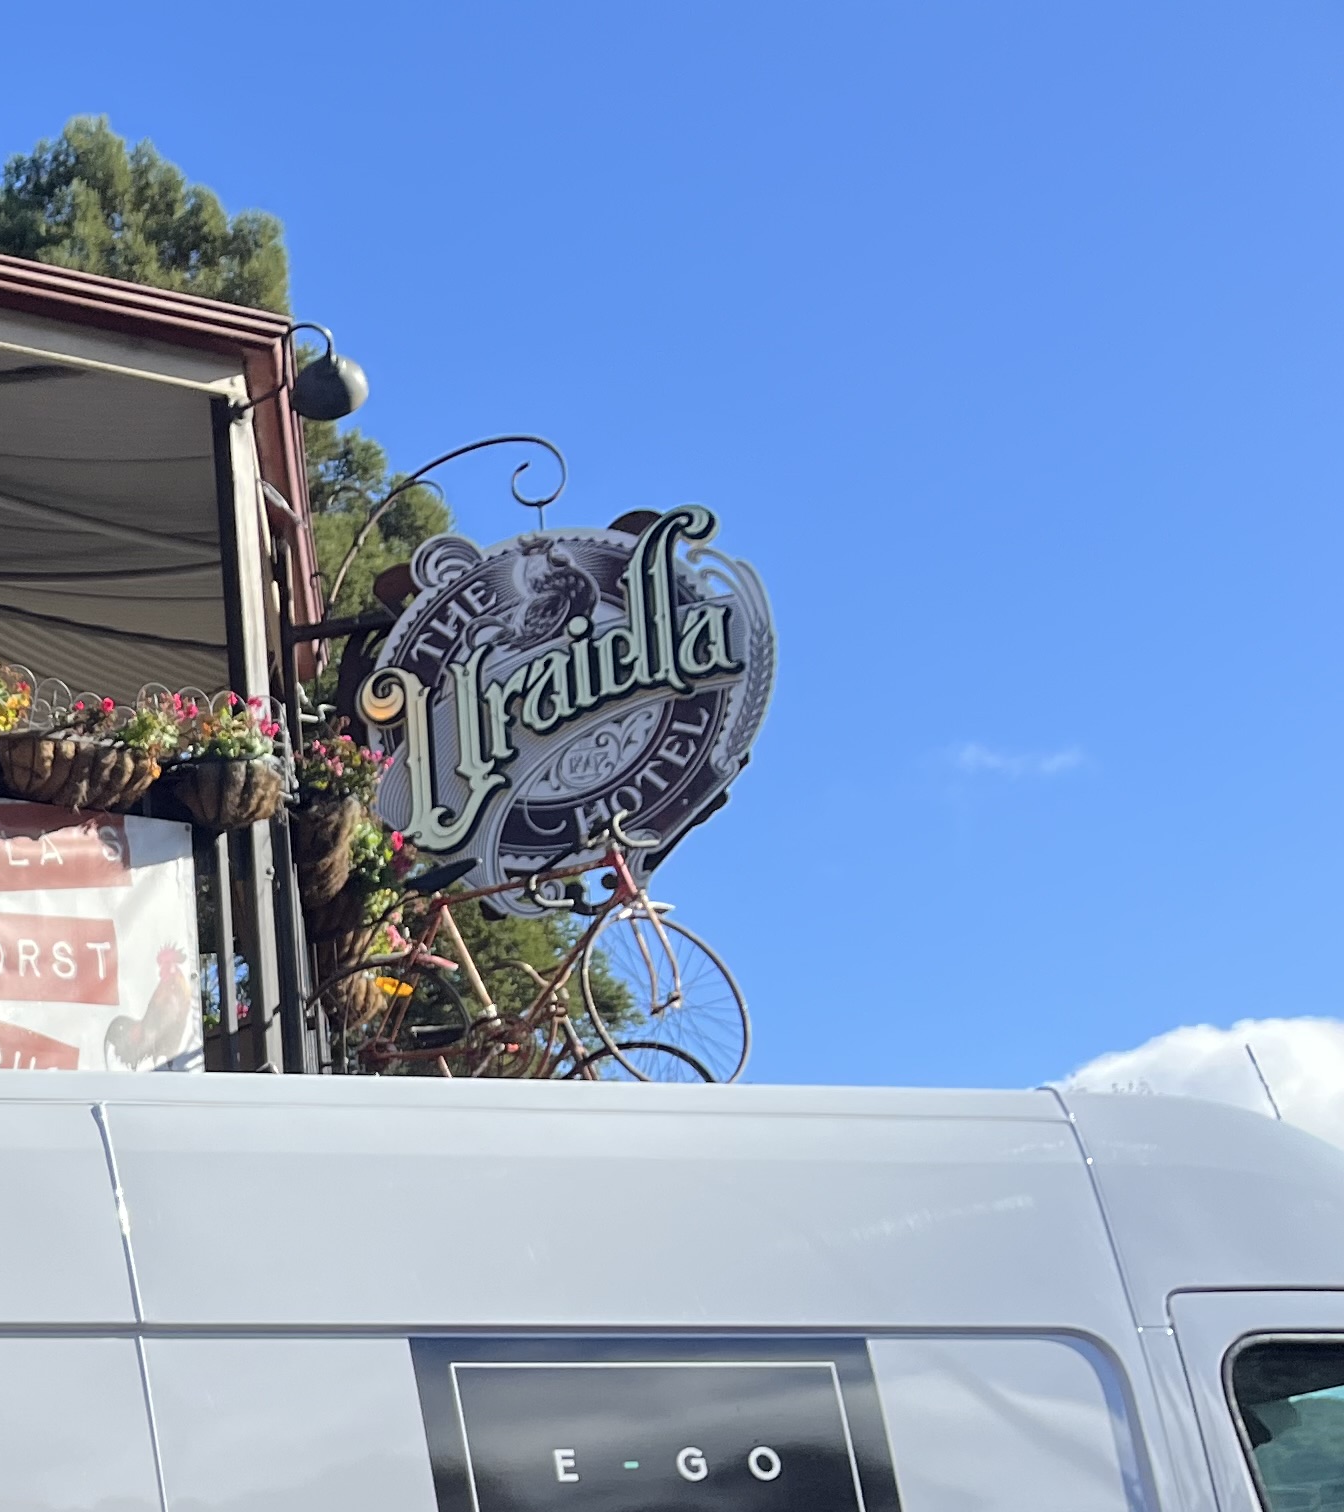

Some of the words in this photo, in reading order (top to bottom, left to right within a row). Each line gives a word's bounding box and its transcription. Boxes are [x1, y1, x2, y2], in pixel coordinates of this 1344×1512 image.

[361, 507, 740, 851] Uraidla
[411, 580, 497, 662] THE
[574, 707, 710, 843] HOTEL
